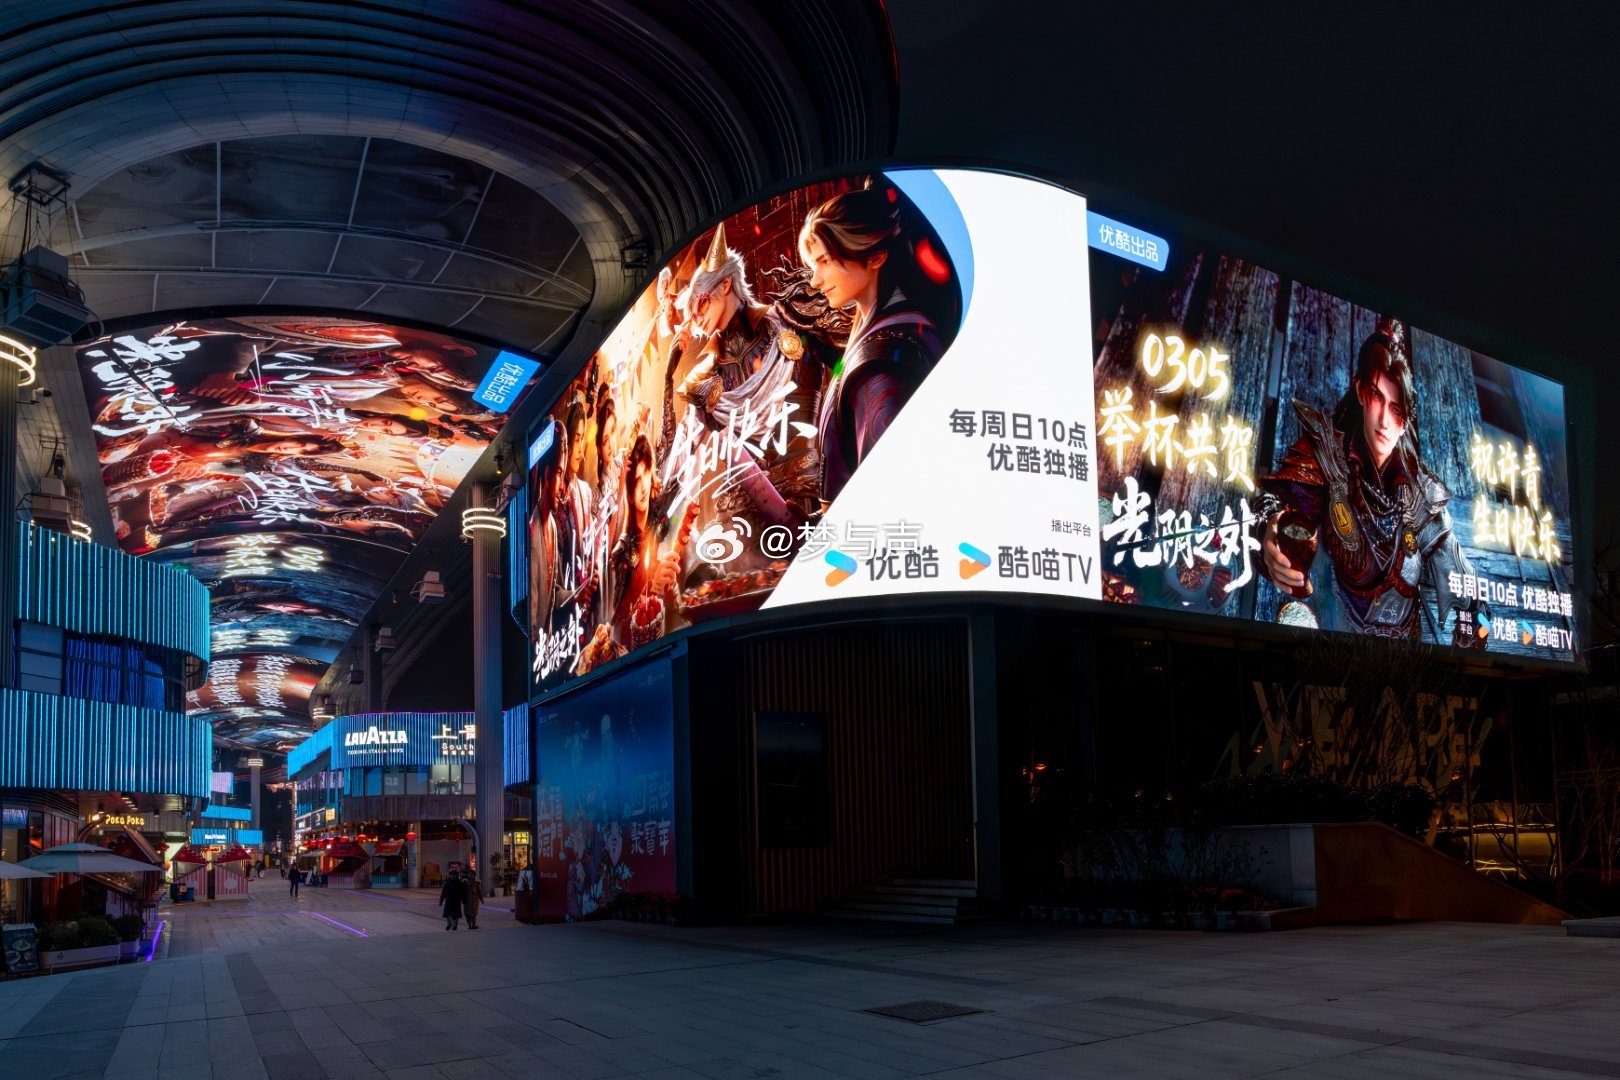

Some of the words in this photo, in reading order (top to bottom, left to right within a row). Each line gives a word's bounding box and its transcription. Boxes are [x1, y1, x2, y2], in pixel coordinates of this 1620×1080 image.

[1099, 223, 1158, 263] 优酷出品
[481, 362, 525, 404] 优酷出品
[1142, 333, 1229, 400] 0305
[663, 381, 819, 518] 生日快乐
[949, 408, 1088, 450] 每周日10点
[1097, 386, 1255, 492] 举杯共贺
[987, 443, 1089, 482] 优酷独播
[1471, 433, 1541, 511] 祝许青
[1051, 519, 1091, 537] 播出平台
[1103, 476, 1262, 592] 光阴之外
[1473, 495, 1561, 563] 生日快乐
[865, 545, 939, 581] 优酷
[998, 545, 1092, 584] 酷喵TV
[1448, 571, 1518, 607] 每周日10点
[1521, 585, 1573, 617] 优酷独播
[1492, 617, 1518, 642] 优酷
[1535, 624, 1573, 650] 酷喵TV
[345, 726, 408, 746] LAVAZZA
